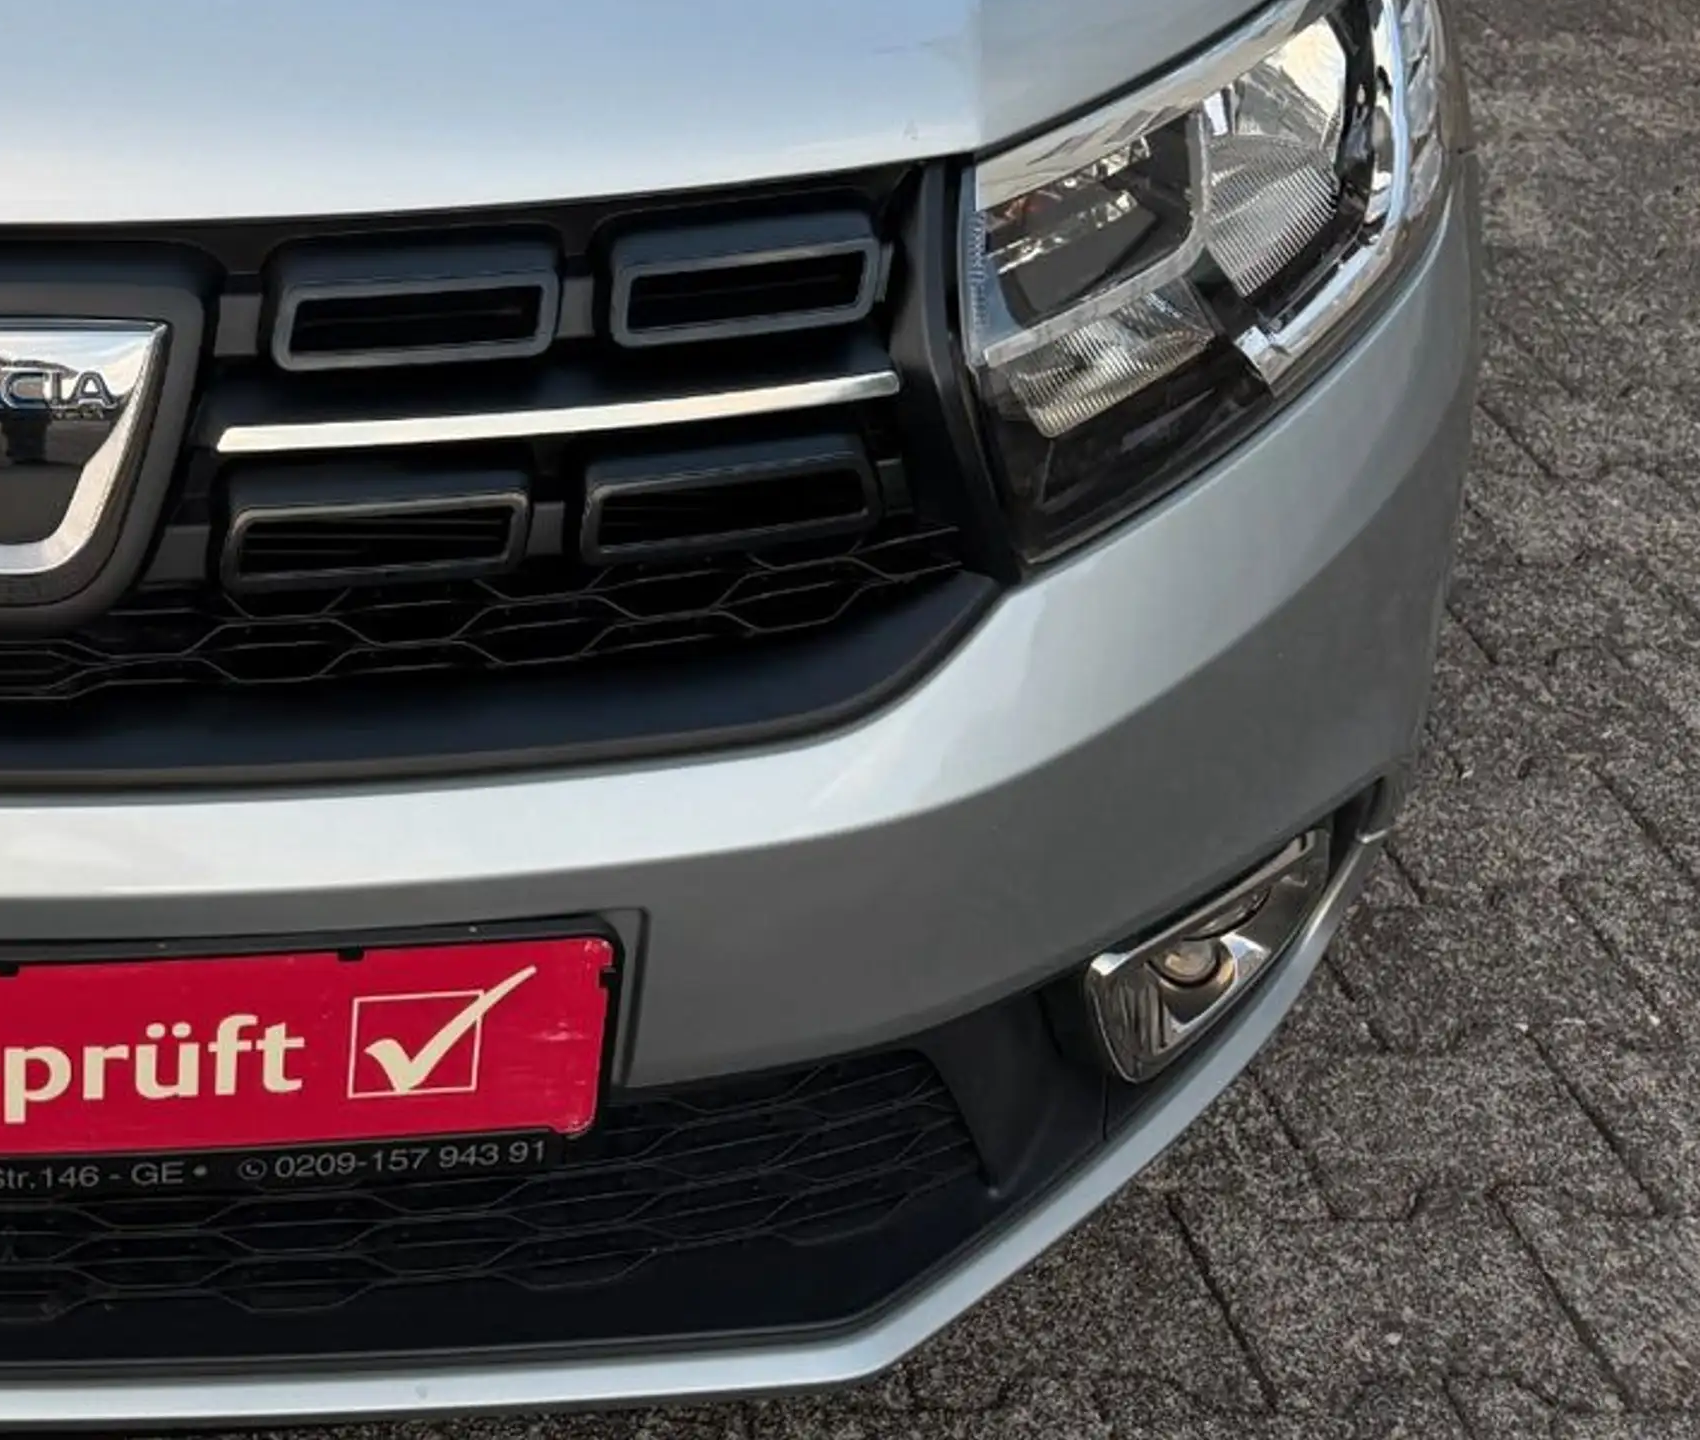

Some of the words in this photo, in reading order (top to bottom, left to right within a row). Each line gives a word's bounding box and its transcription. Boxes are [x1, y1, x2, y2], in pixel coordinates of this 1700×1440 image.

[130, 1162, 184, 1186] GE
[274, 1147, 431, 1179] 0209-157
[438, 1143, 500, 1169] 943
[508, 1139, 547, 1163] 91
